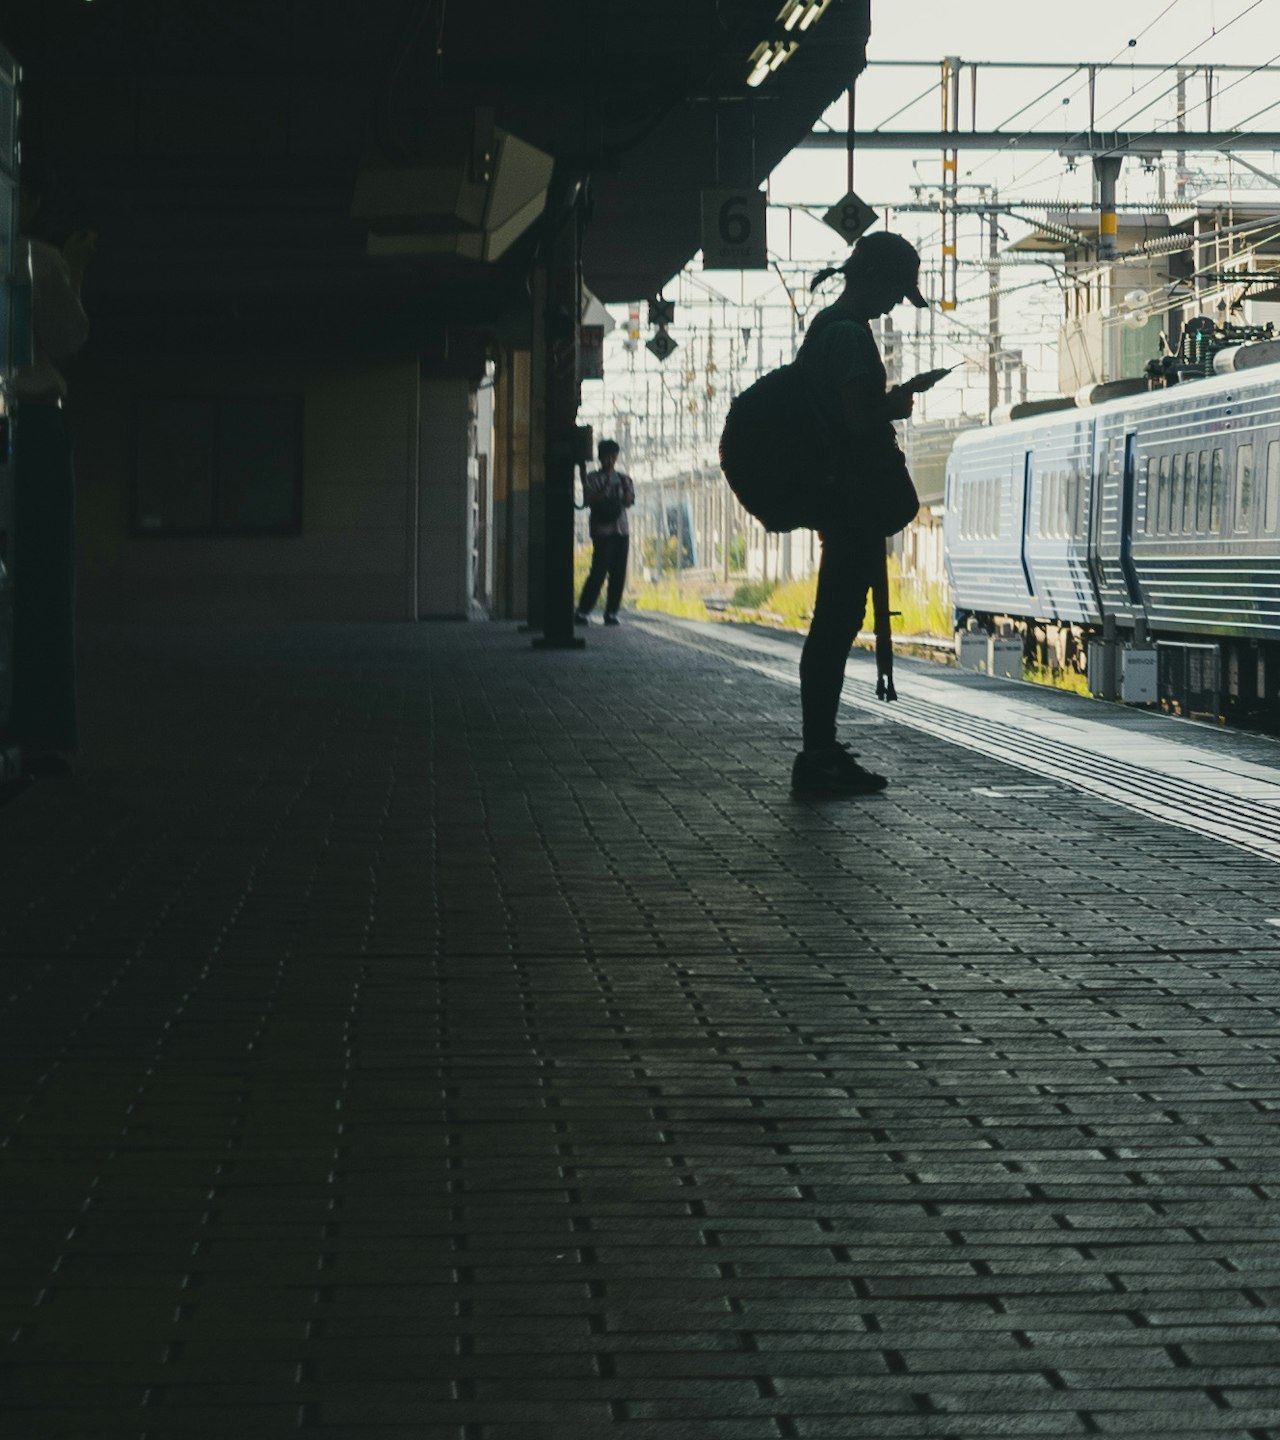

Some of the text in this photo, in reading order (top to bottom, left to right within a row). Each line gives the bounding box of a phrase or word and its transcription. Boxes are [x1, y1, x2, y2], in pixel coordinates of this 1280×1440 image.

[719, 196, 751, 244] 6
[840, 203, 861, 232] 8
[655, 336, 669, 356] 9
